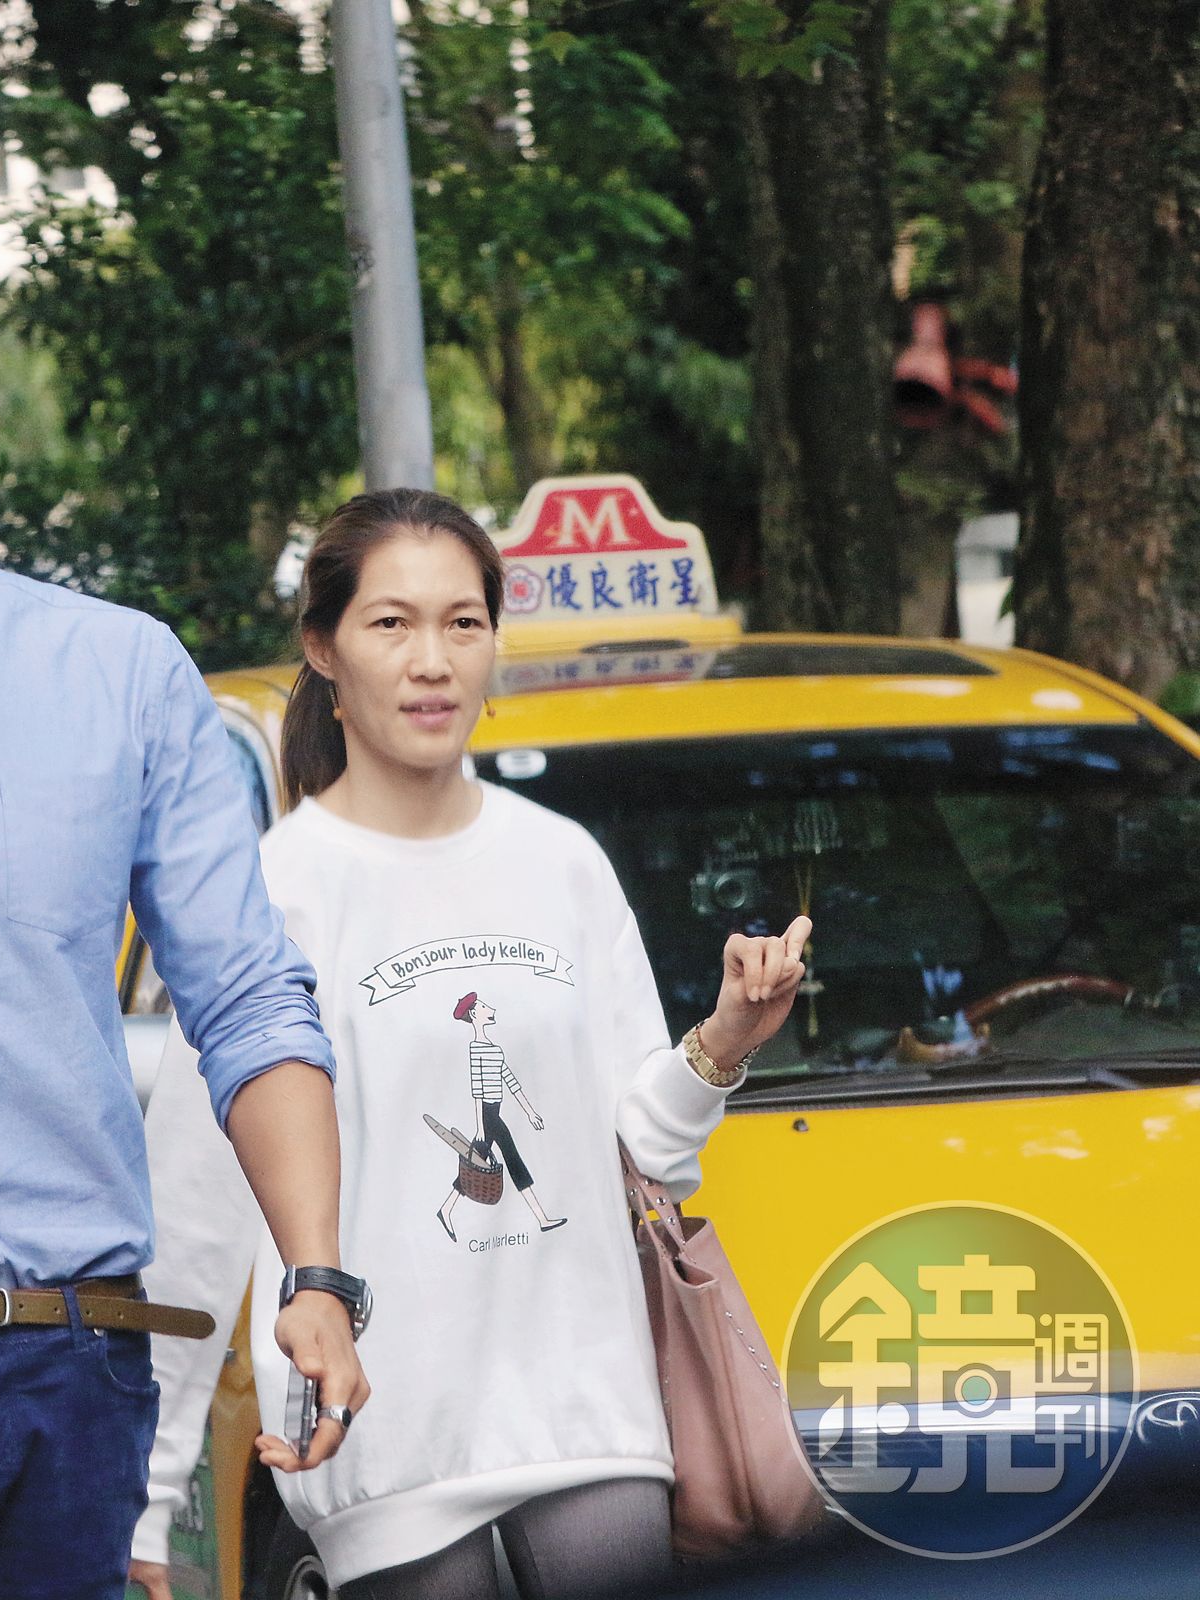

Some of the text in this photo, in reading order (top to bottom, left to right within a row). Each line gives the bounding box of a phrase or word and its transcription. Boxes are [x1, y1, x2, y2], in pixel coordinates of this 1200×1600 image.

[544, 492, 640, 551] M
[546, 556, 700, 611] 優良衛星
[391, 941, 545, 978] Bonjour lady kellen
[468, 1237, 490, 1253] Carl
